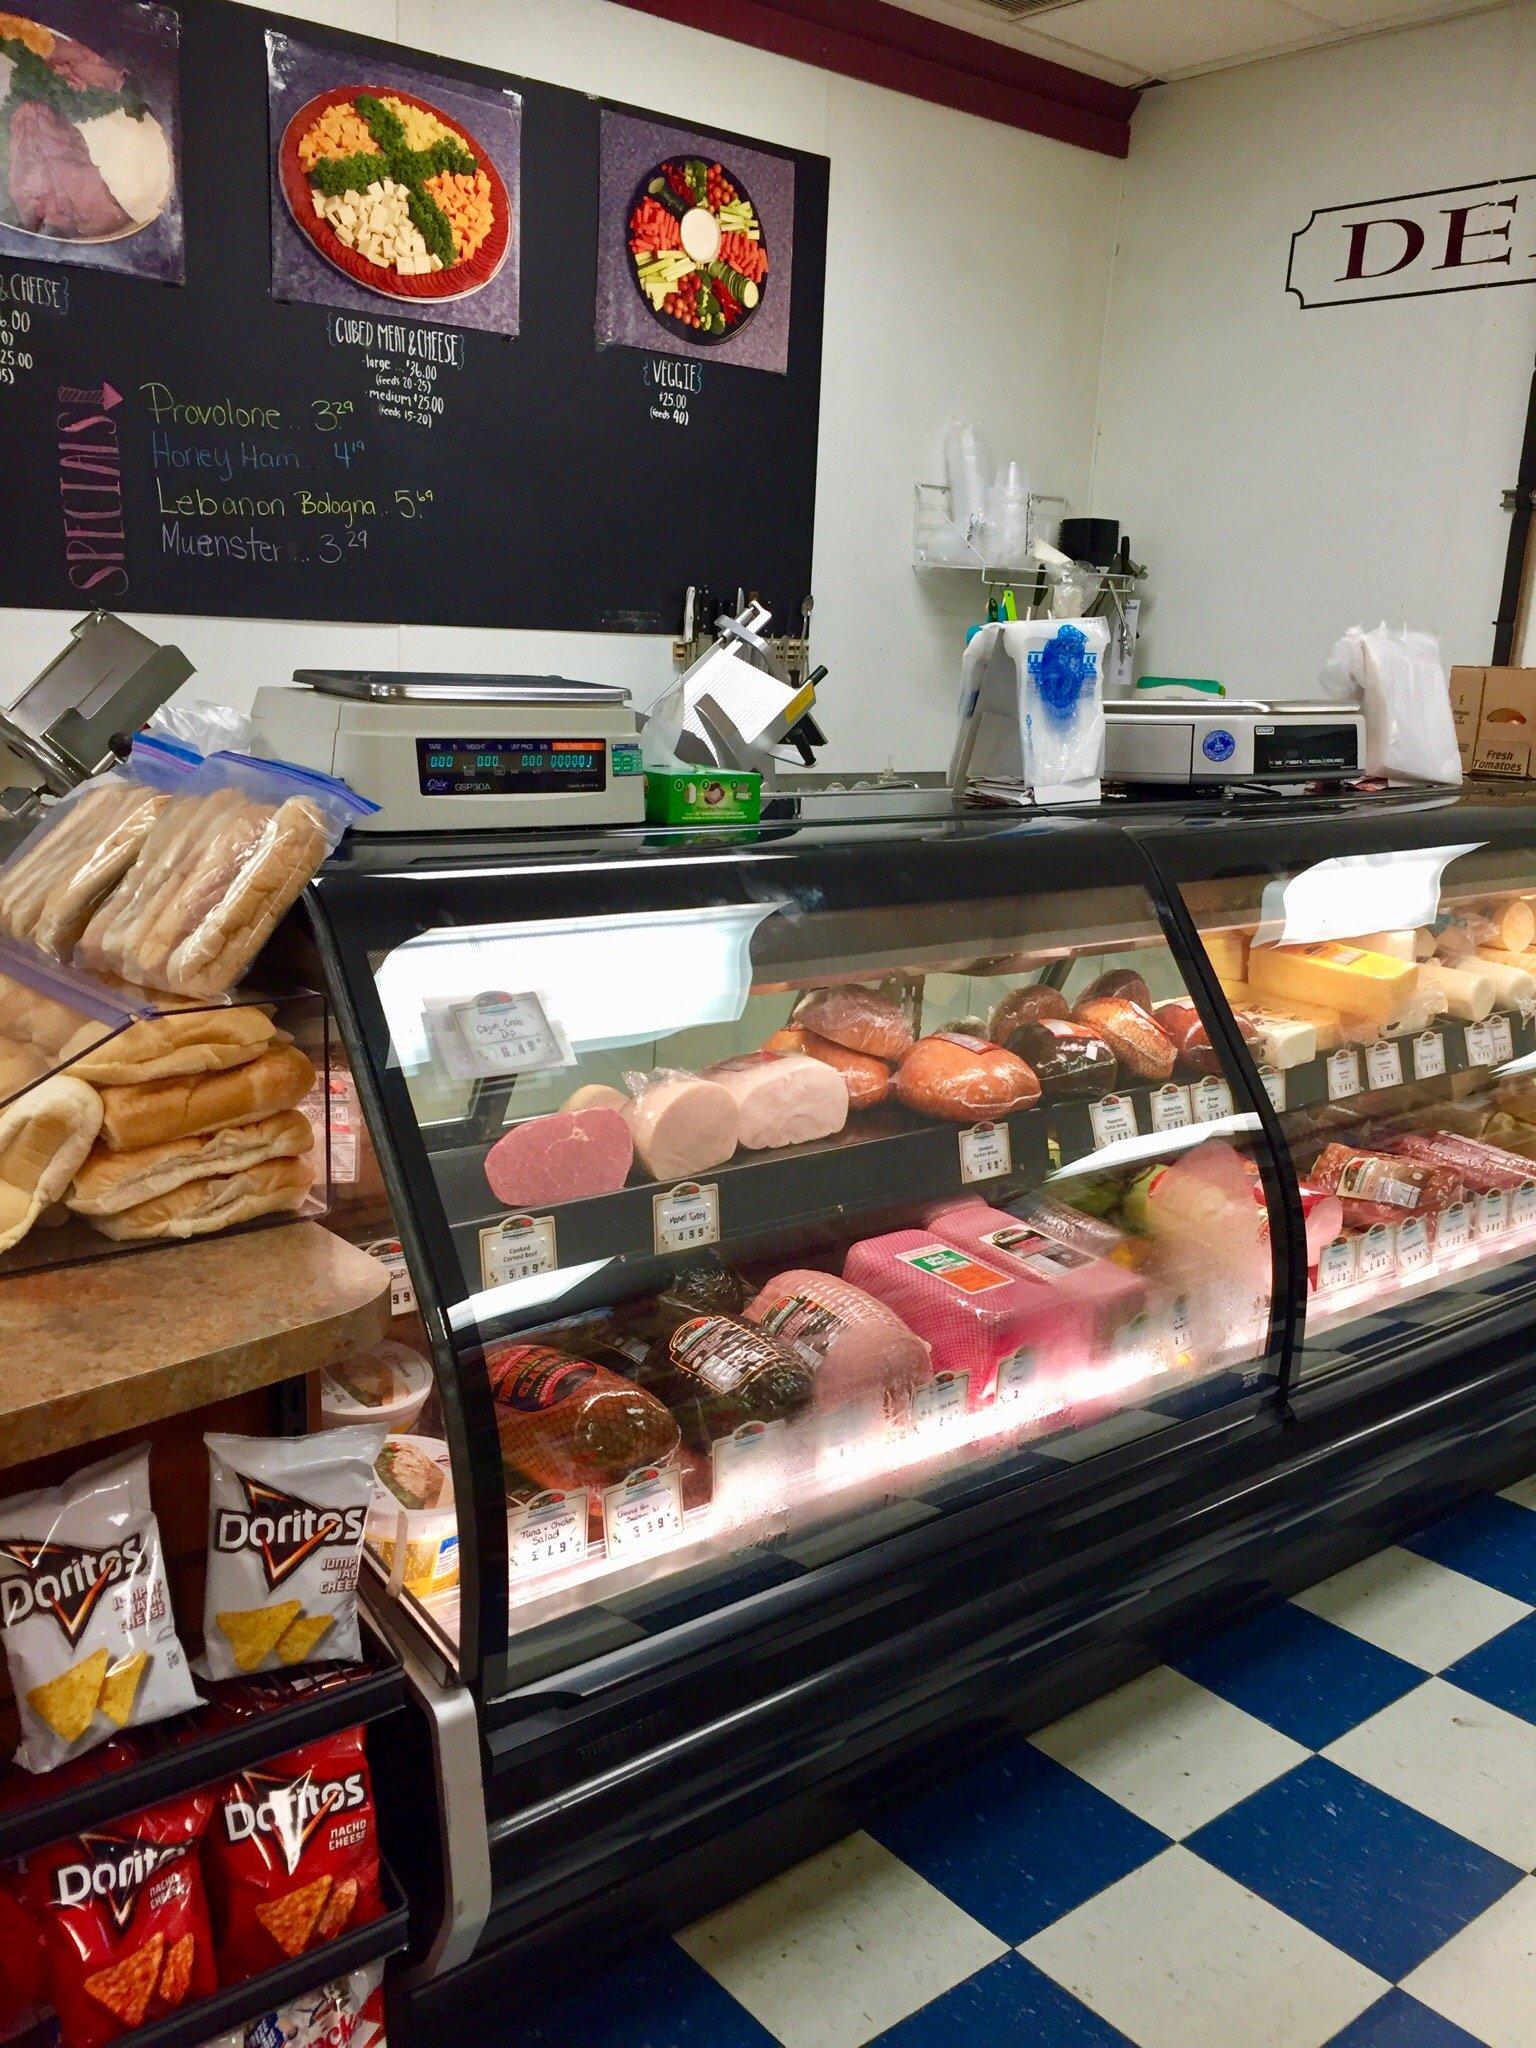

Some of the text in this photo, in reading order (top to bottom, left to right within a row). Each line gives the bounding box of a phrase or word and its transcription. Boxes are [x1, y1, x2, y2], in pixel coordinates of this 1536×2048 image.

[1334, 194, 1536, 282] DE
[10, 273, 61, 308] CHEESE
[335, 317, 459, 366] CUBED MEAT & CHEESE
[366, 354, 391, 372] large
[375, 373, 400, 387] (feeds
[653, 359, 697, 392] VEGGIE
[140, 382, 281, 430] Provolone
[369, 389, 412, 407] medium
[659, 391, 687, 409] $25.00
[404, 410, 433, 429] 15-20)
[650, 406, 690, 426] (feeds 40)
[152, 430, 233, 482] Honey
[241, 441, 300, 469] Ham
[57, 412, 129, 596] SPECIALS
[156, 477, 285, 517] Lebanon
[293, 490, 376, 528] Bologna
[162, 521, 282, 562] Muenster
[1473, 759, 1522, 771] Tomatoes
[1487, 749, 1514, 761] Fresh
[476, 1021, 501, 1035] Cajun
[500, 1028, 516, 1039] Dip
[503, 1251, 538, 1263] Corned Beef
[509, 1245, 531, 1254] Cooked
[218, 1508, 364, 1550] Doritos
[520, 1516, 576, 1539] Tuna Chicken
[532, 1529, 560, 1546] Salad
[0, 1537, 142, 1627] Doritos
[328, 1829, 366, 1851] CHEESE
[330, 1819, 367, 1840] NACHO
